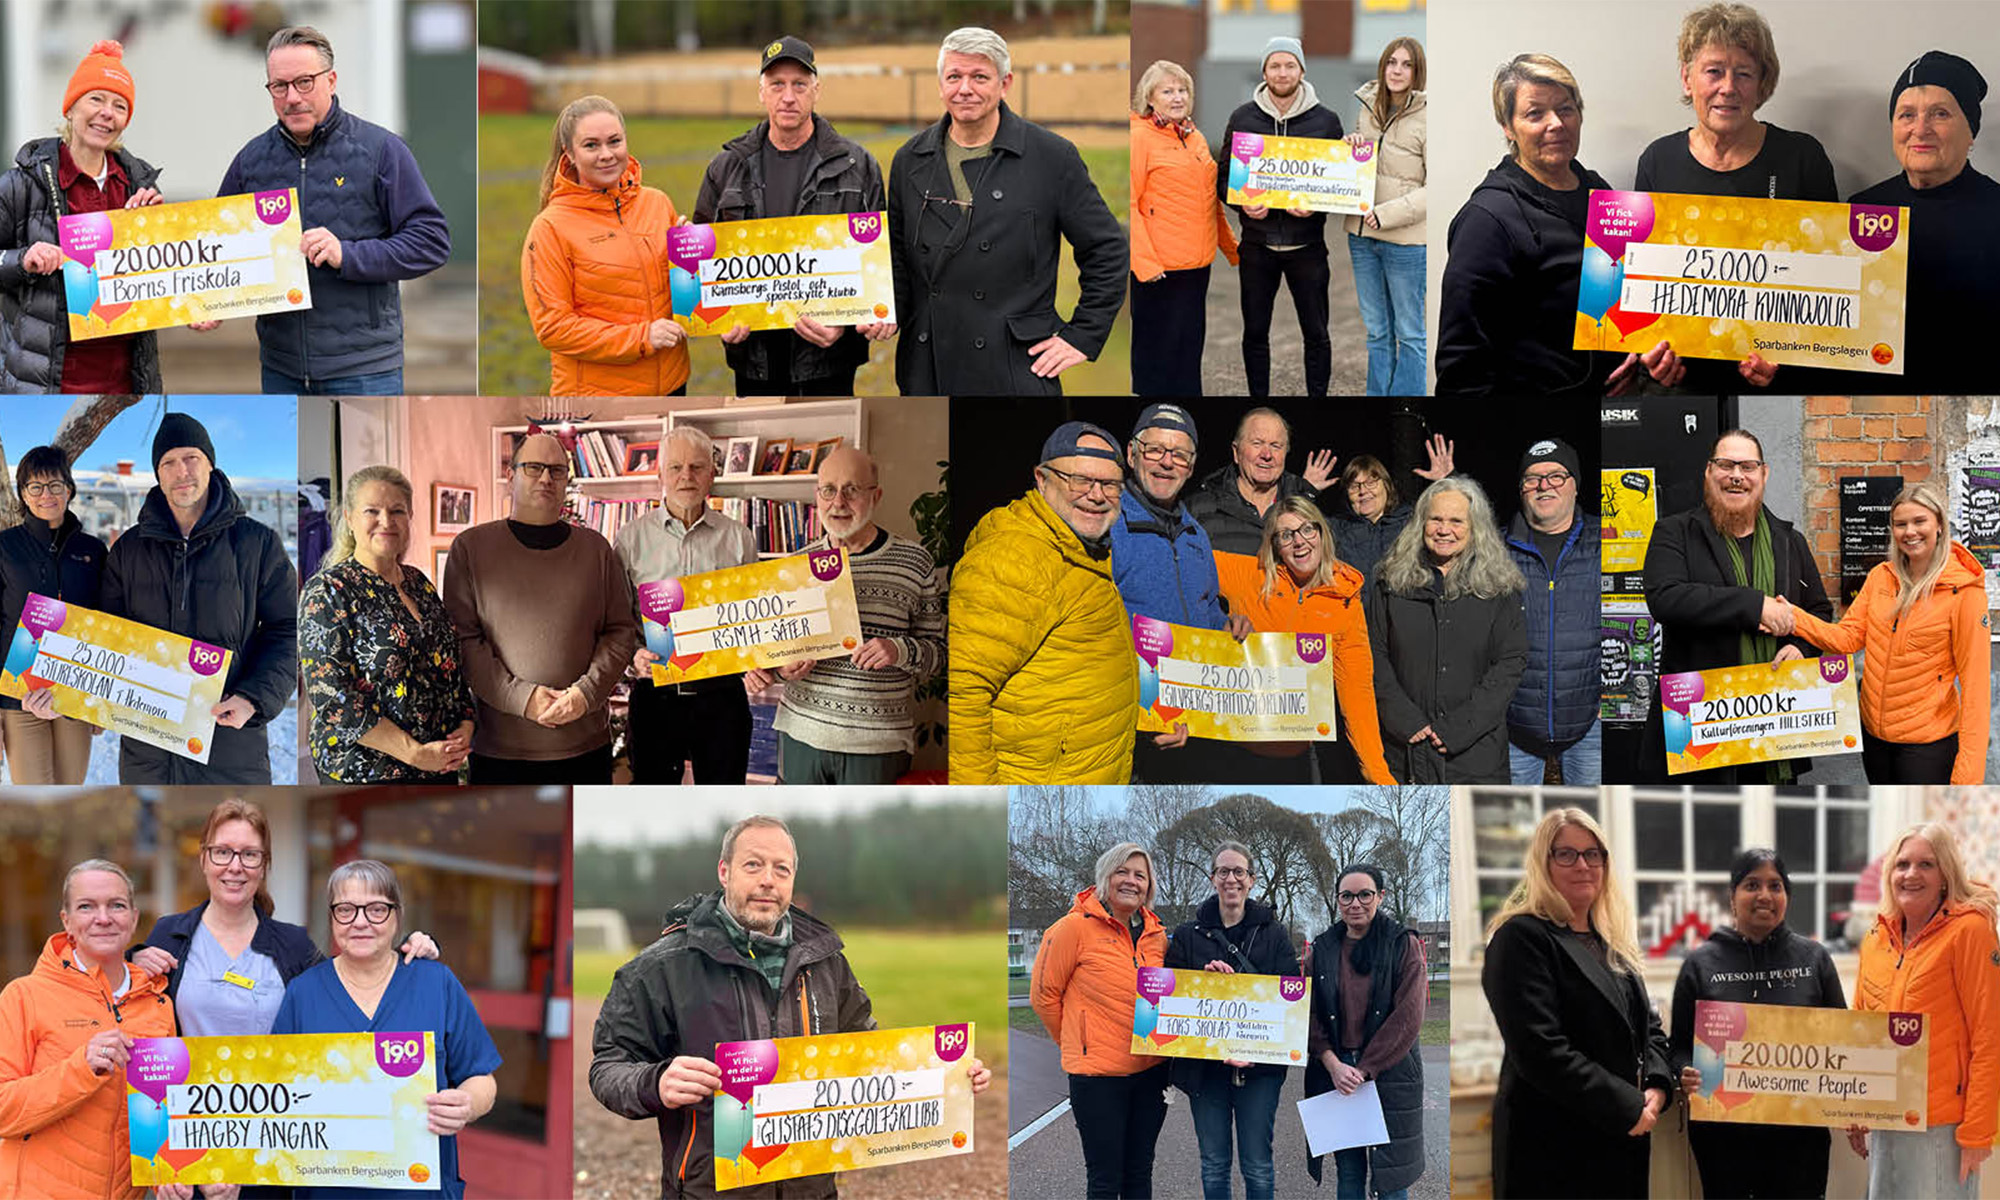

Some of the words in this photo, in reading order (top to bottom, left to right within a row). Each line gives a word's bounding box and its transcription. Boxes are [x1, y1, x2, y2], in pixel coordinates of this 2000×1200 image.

[1258, 158, 1310, 176] 25.000
[1312, 162, 1327, 177] kr
[260, 195, 287, 217] 190
[1606, 208, 1614, 216] Vi
[852, 216, 878, 235] 190
[1612, 218, 1627, 226] del
[1856, 212, 1894, 237] 190
[1604, 228, 1632, 237] kakan!
[112, 240, 194, 276] 20.000
[198, 239, 223, 263] kr
[714, 253, 791, 281] 20.000
[796, 252, 818, 275] kr
[113, 279, 166, 302] Borns
[173, 268, 241, 296] Friskola
[711, 284, 768, 298] Ramsbergs
[809, 278, 827, 290] och
[828, 286, 857, 298] klubb
[1754, 339, 1811, 352] Sparbanken
[1813, 344, 1868, 357] Bergslagen
[813, 555, 839, 573] 190
[193, 647, 220, 664] 190
[1300, 638, 1323, 654] 190
[1822, 660, 1845, 676] 190
[1704, 694, 1772, 721] 20.000
[1776, 692, 1796, 713] kr
[1701, 721, 1775, 740] Kulturföreningen
[1779, 710, 1839, 730] HILLSTREET
[1710, 971, 1767, 984] AWESOME
[1769, 967, 1813, 980] PEOPLE
[1283, 981, 1303, 995] 190
[1892, 1017, 1919, 1036] 190
[938, 1030, 965, 1049] 190
[380, 1040, 419, 1064] 190
[1741, 1042, 1819, 1069] 20.000
[1825, 1046, 1848, 1070] kr
[732, 1074, 758, 1083] kakan!
[1737, 1071, 1810, 1093] Awesome
[1818, 1074, 1867, 1101] People
[184, 1120, 251, 1149] HAGBY
[867, 1143, 911, 1156] Sparbanken
[911, 1137, 950, 1151] Bergslagen
[296, 1165, 349, 1177] Sparbanken
[352, 1166, 405, 1178] Bergslagen
